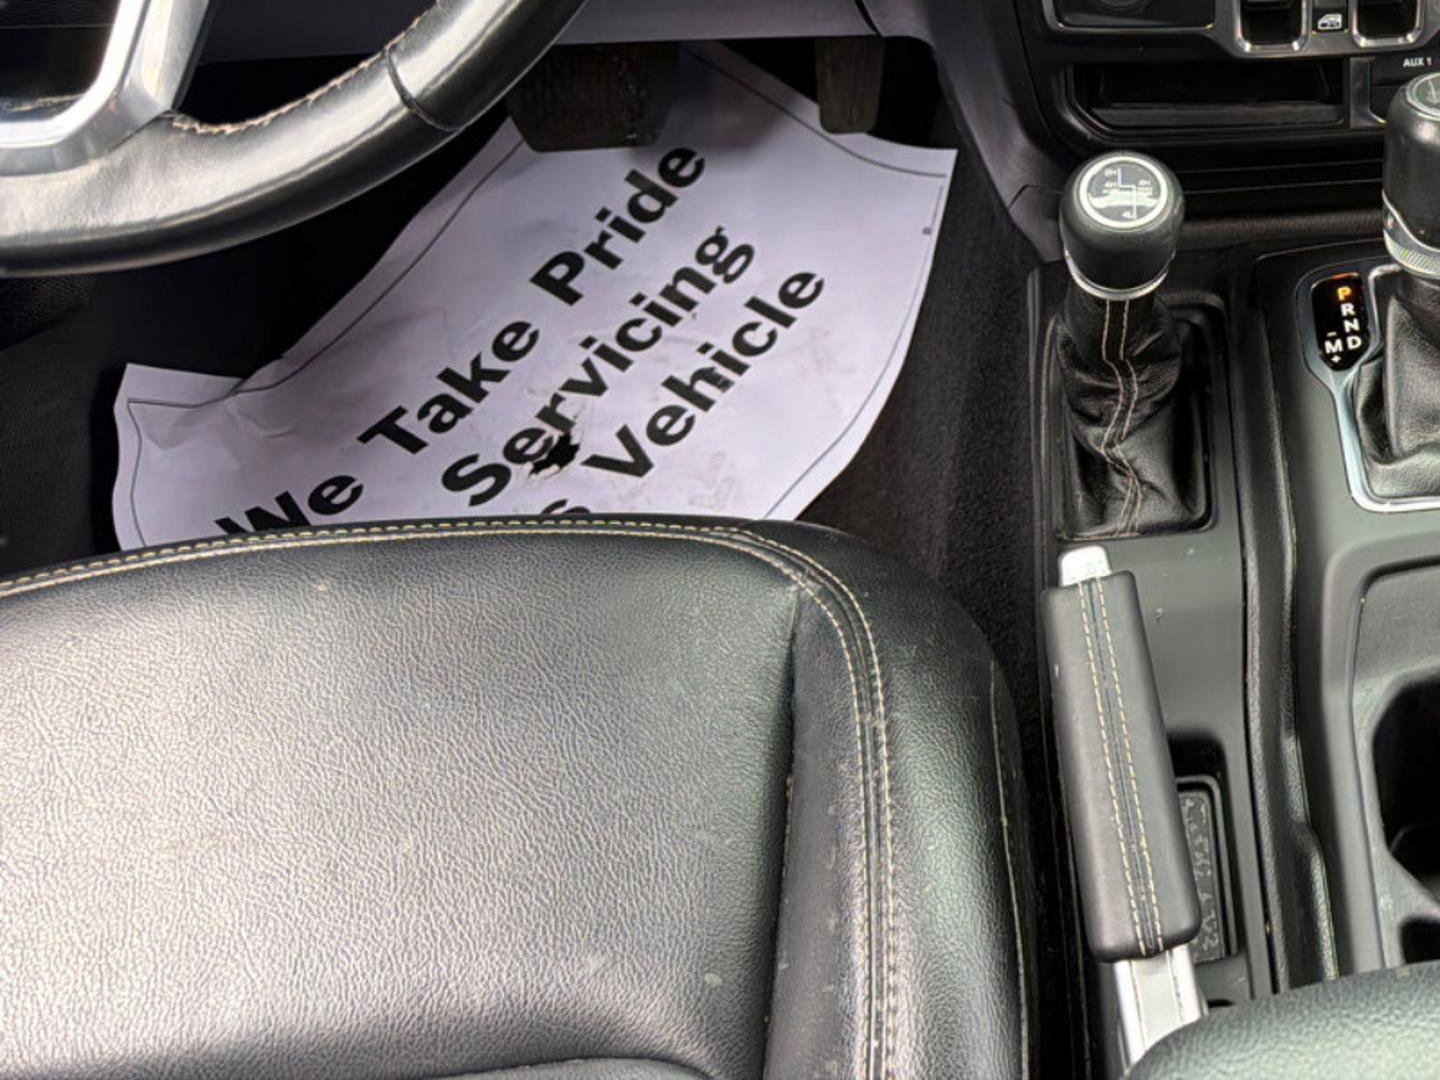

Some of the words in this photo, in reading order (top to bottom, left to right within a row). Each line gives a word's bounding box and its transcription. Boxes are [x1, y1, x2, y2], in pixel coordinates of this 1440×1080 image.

[1403, 57, 1425, 68] AUX
[357, 319, 540, 455] Take
[529, 146, 706, 307] Pride
[1337, 286, 1352, 301] P
[1340, 302, 1356, 317] R
[1343, 318, 1360, 332] N
[1324, 339, 1344, 355] M
[1347, 336, 1362, 351] D
[441, 225, 755, 507] Servicing
[580, 271, 825, 479] Vehicle
